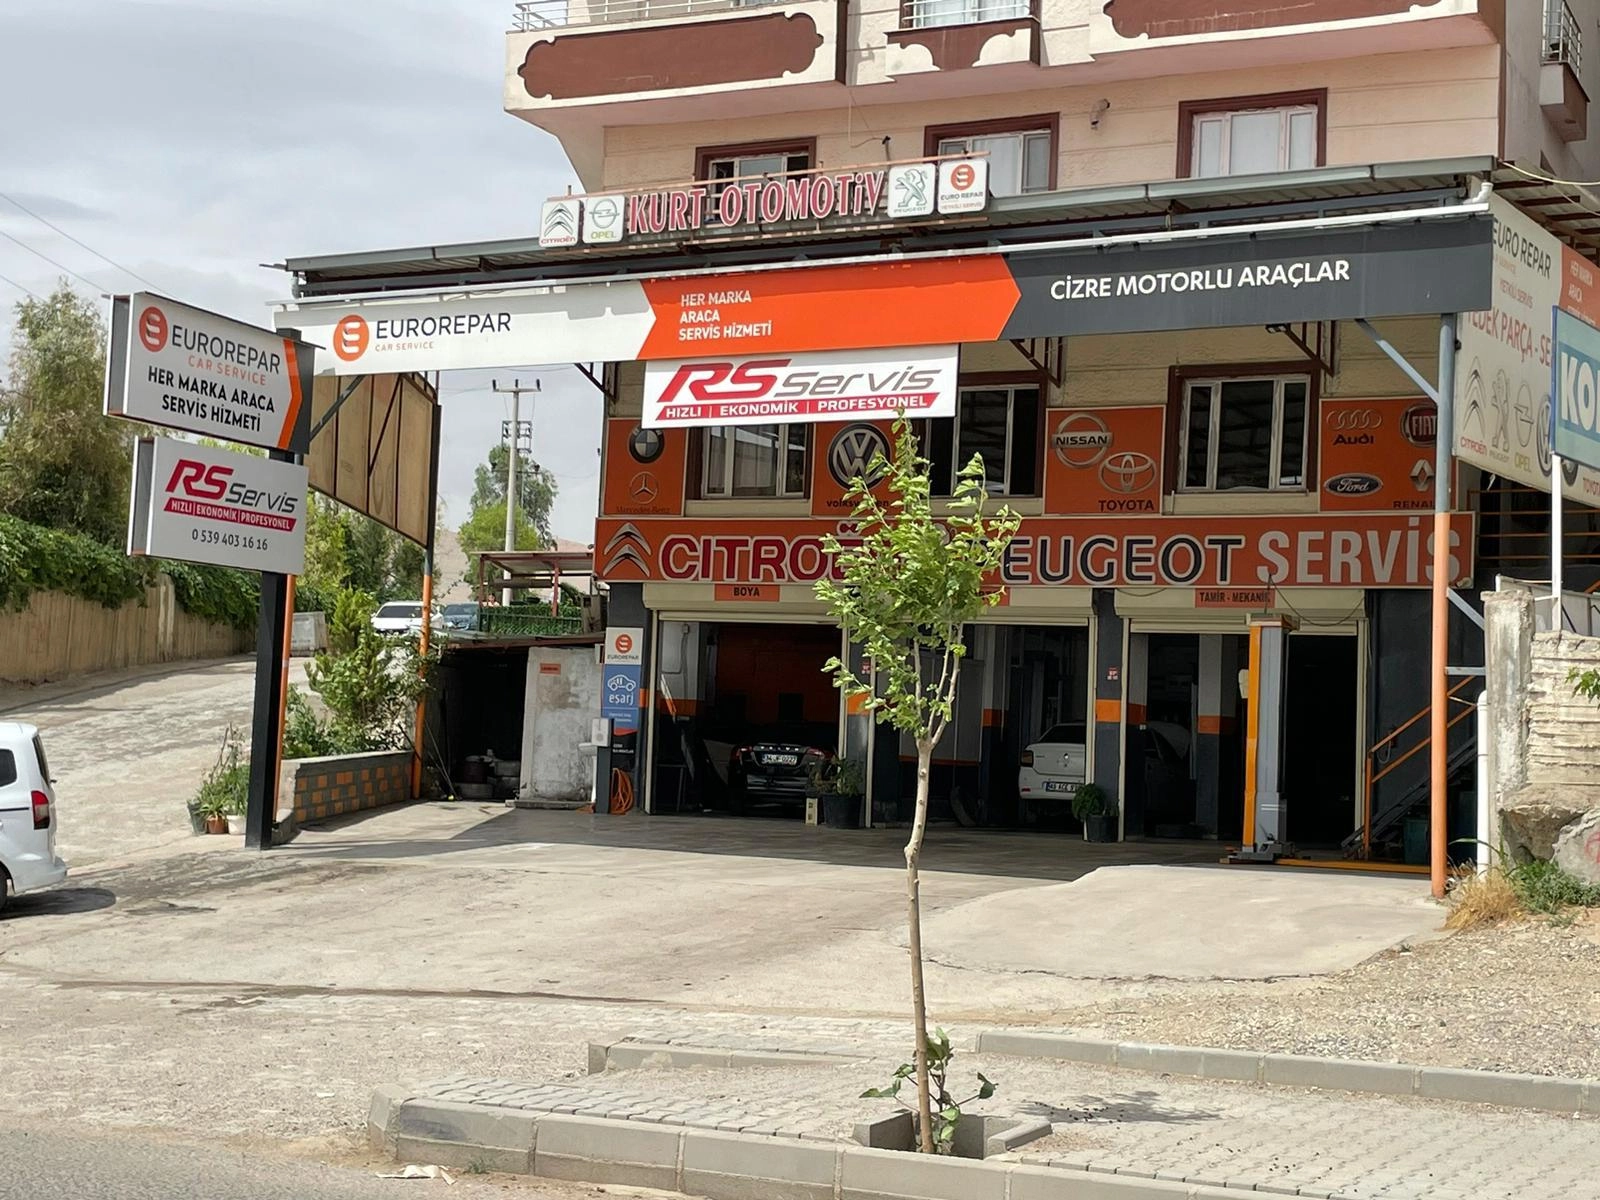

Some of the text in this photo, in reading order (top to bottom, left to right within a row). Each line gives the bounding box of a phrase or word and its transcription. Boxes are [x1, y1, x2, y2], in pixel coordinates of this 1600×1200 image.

[628, 188, 707, 235] KURT
[590, 230, 617, 240] OPEL
[1521, 237, 1552, 280] REPAR
[1050, 259, 1350, 301] CİZRE MOTORLU ARAÇLAR
[681, 290, 752, 307] HER MARKA
[376, 312, 512, 340] EUROREPAR
[679, 310, 720, 324] ARACA
[678, 319, 773, 341] SERVİS HİZMETİ
[171, 324, 281, 375] EUROREPAR
[375, 340, 434, 353] CAR SERVICE
[187, 355, 267, 386] CAR SERVICE
[656, 358, 792, 403] RS
[148, 366, 275, 414] HER MARKA ARACA
[1561, 351, 1600, 434] KO
[162, 394, 262, 432] SERVİS HİZMETİ
[665, 394, 928, 419] HIZLI EKONOMİK PROFESYONEL
[1055, 434, 1109, 446] NISSAN
[1332, 432, 1376, 446] Audi
[165, 458, 234, 501] RS
[1336, 477, 1370, 492] Ford
[171, 500, 291, 530] HIZLI EKONOMİK PROFESYONEL
[1098, 499, 1154, 512] TOYOTA
[1393, 500, 1434, 509] RENA
[192, 528, 268, 551] 0 539 403 16 16
[733, 586, 760, 598] BOYA
